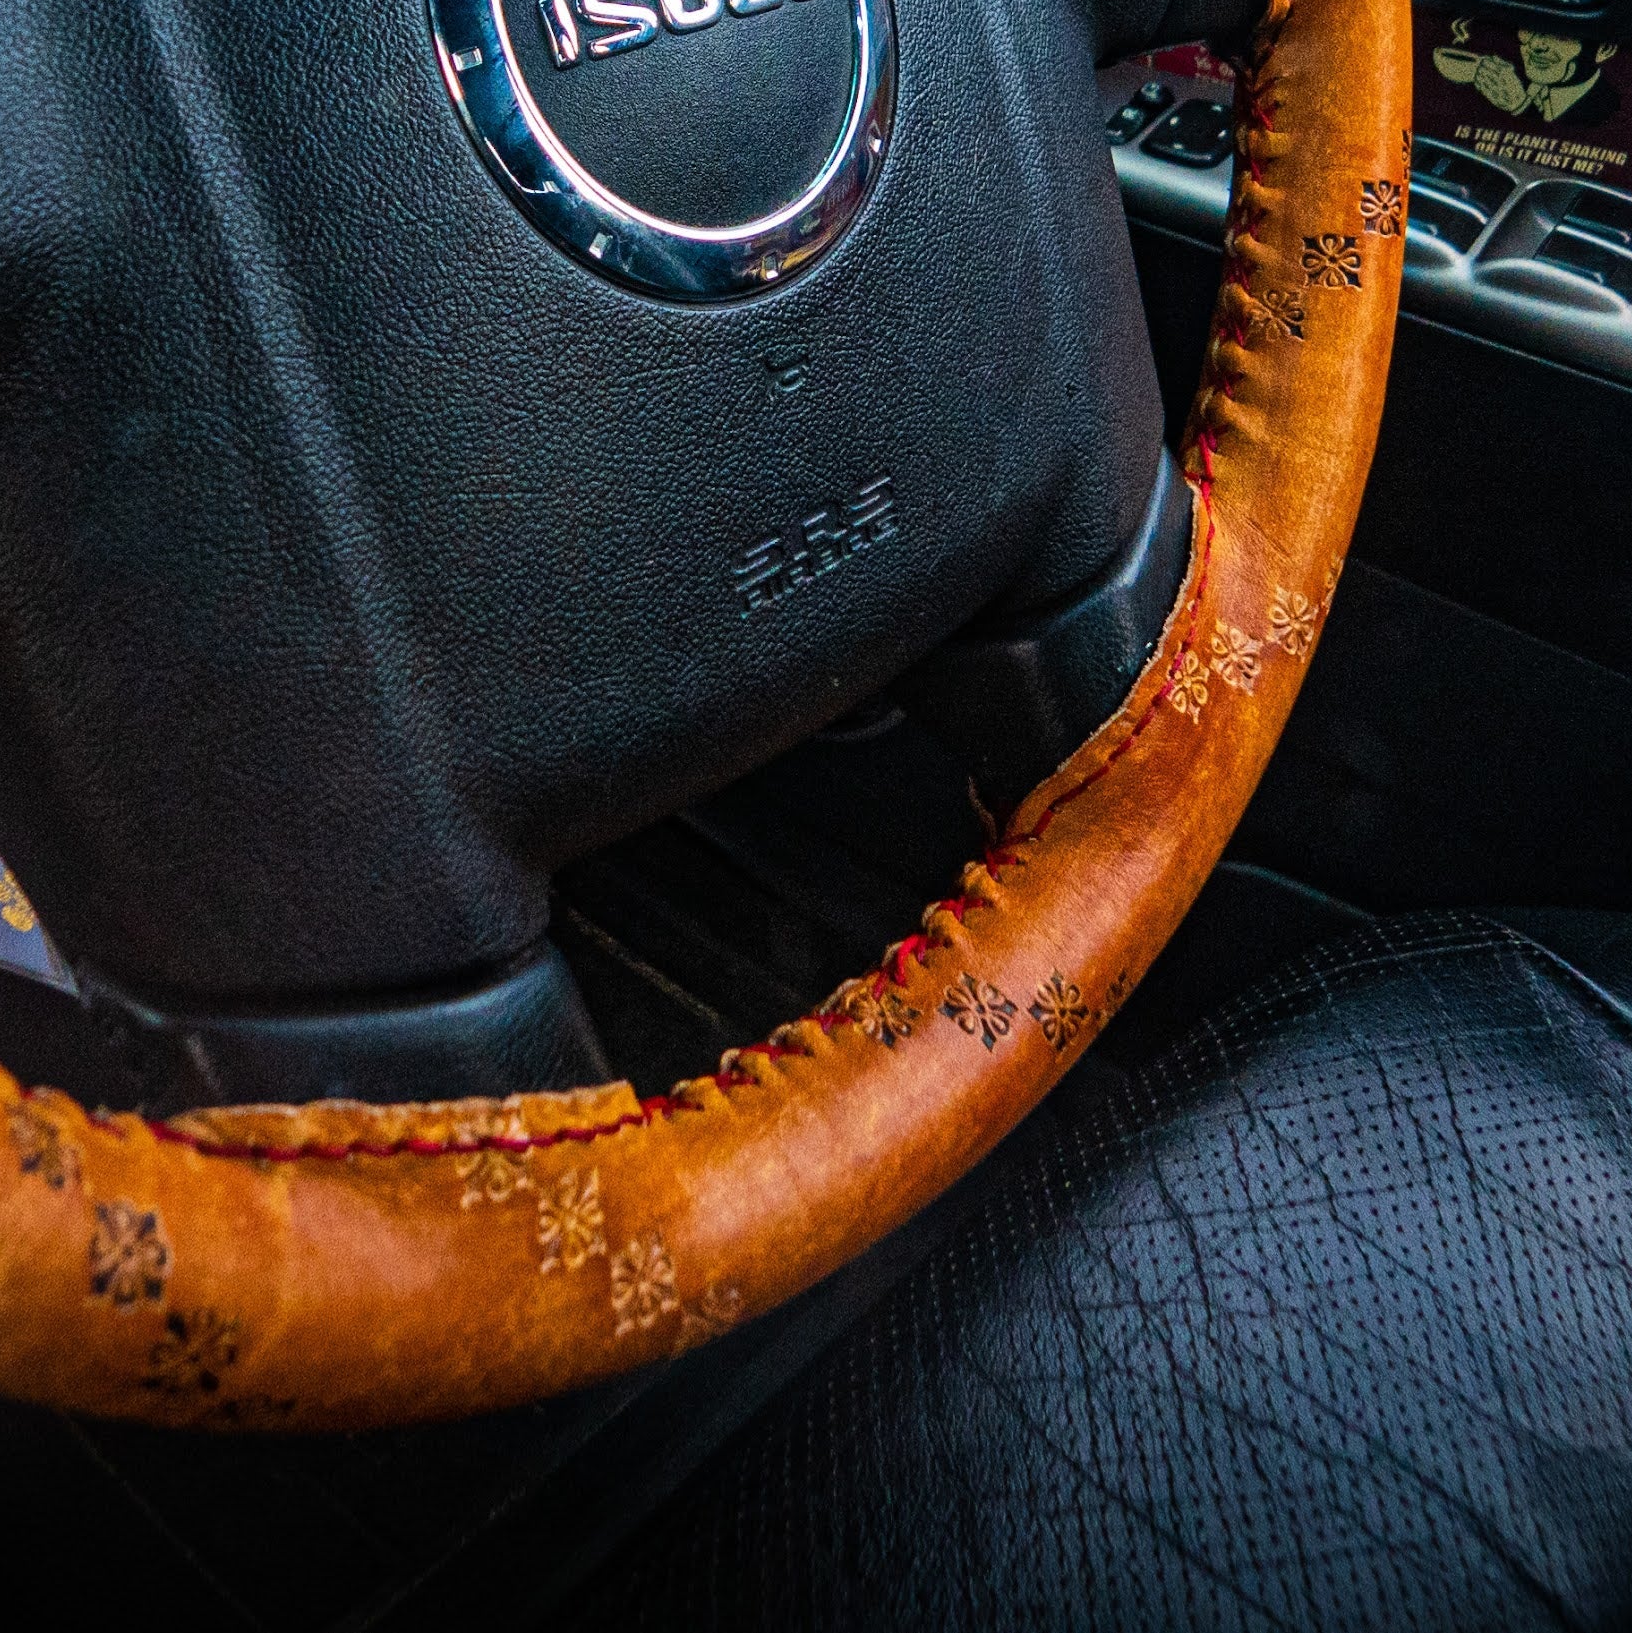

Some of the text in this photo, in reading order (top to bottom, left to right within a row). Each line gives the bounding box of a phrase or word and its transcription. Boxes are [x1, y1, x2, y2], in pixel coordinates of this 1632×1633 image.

[1454, 124, 1629, 167] IS THE PLANET SHAKING
[1474, 140, 1605, 176] OR IS IT JUST ME?
[732, 474, 896, 593] SRS
